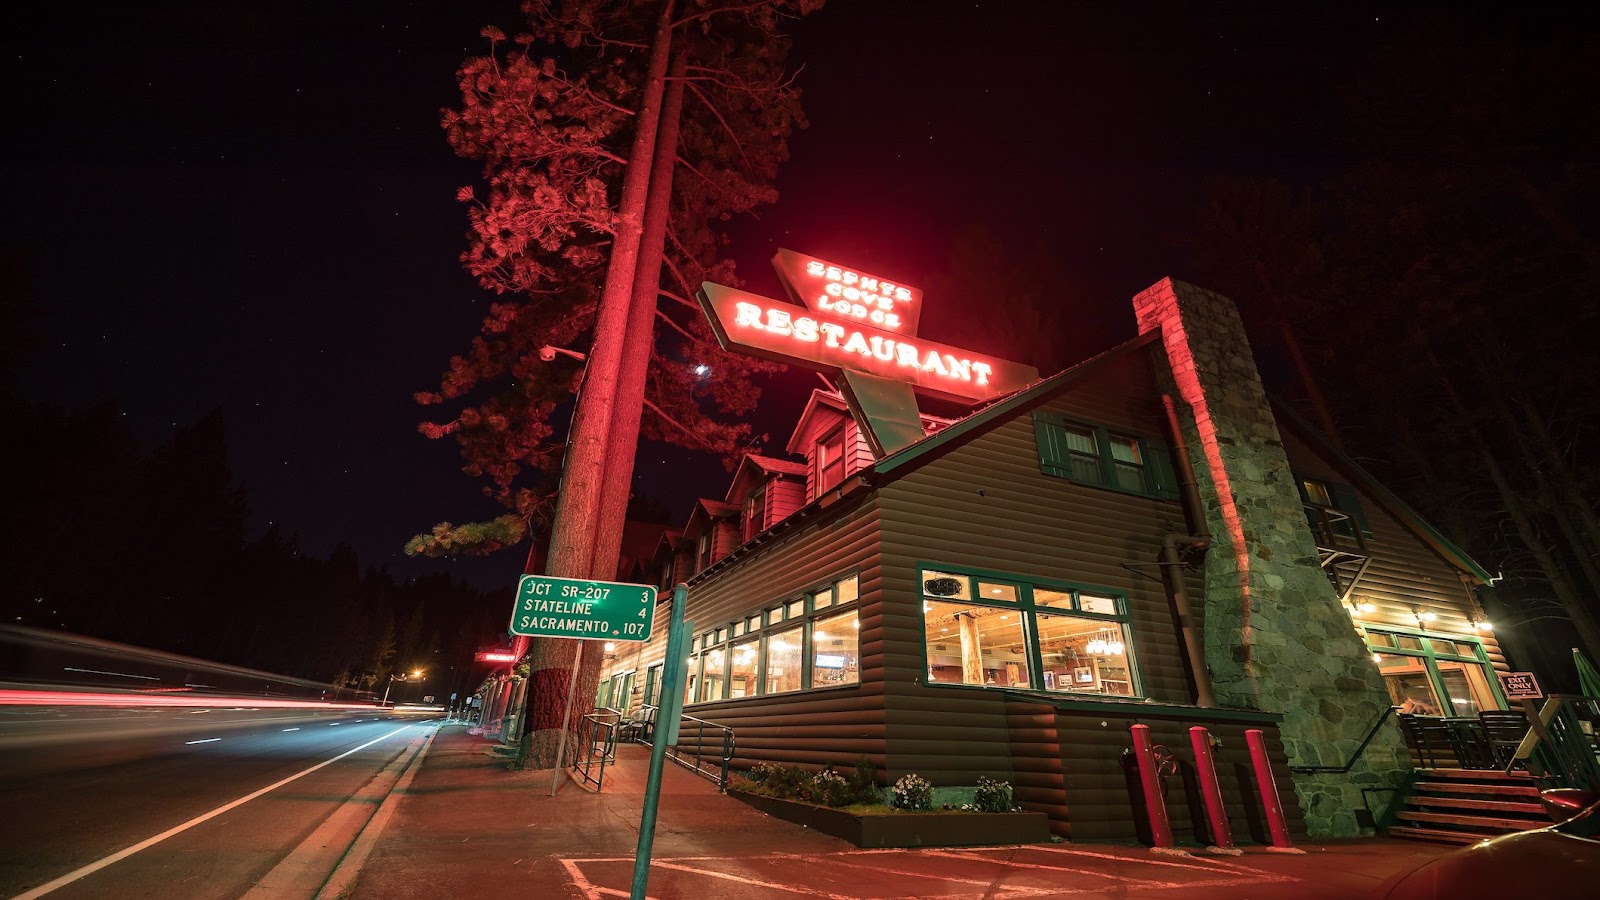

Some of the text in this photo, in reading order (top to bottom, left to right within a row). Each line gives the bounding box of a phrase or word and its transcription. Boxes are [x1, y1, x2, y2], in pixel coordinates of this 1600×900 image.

[806, 261, 912, 302] ZEPHYR
[825, 283, 893, 310] COVE
[818, 295, 902, 327] LODGE
[735, 301, 992, 385] RESTAURANT
[526, 582, 649, 603] JCT SR-207 3
[524, 599, 647, 619] STATELINE 4
[520, 616, 645, 635] SACRAMENTO 107
